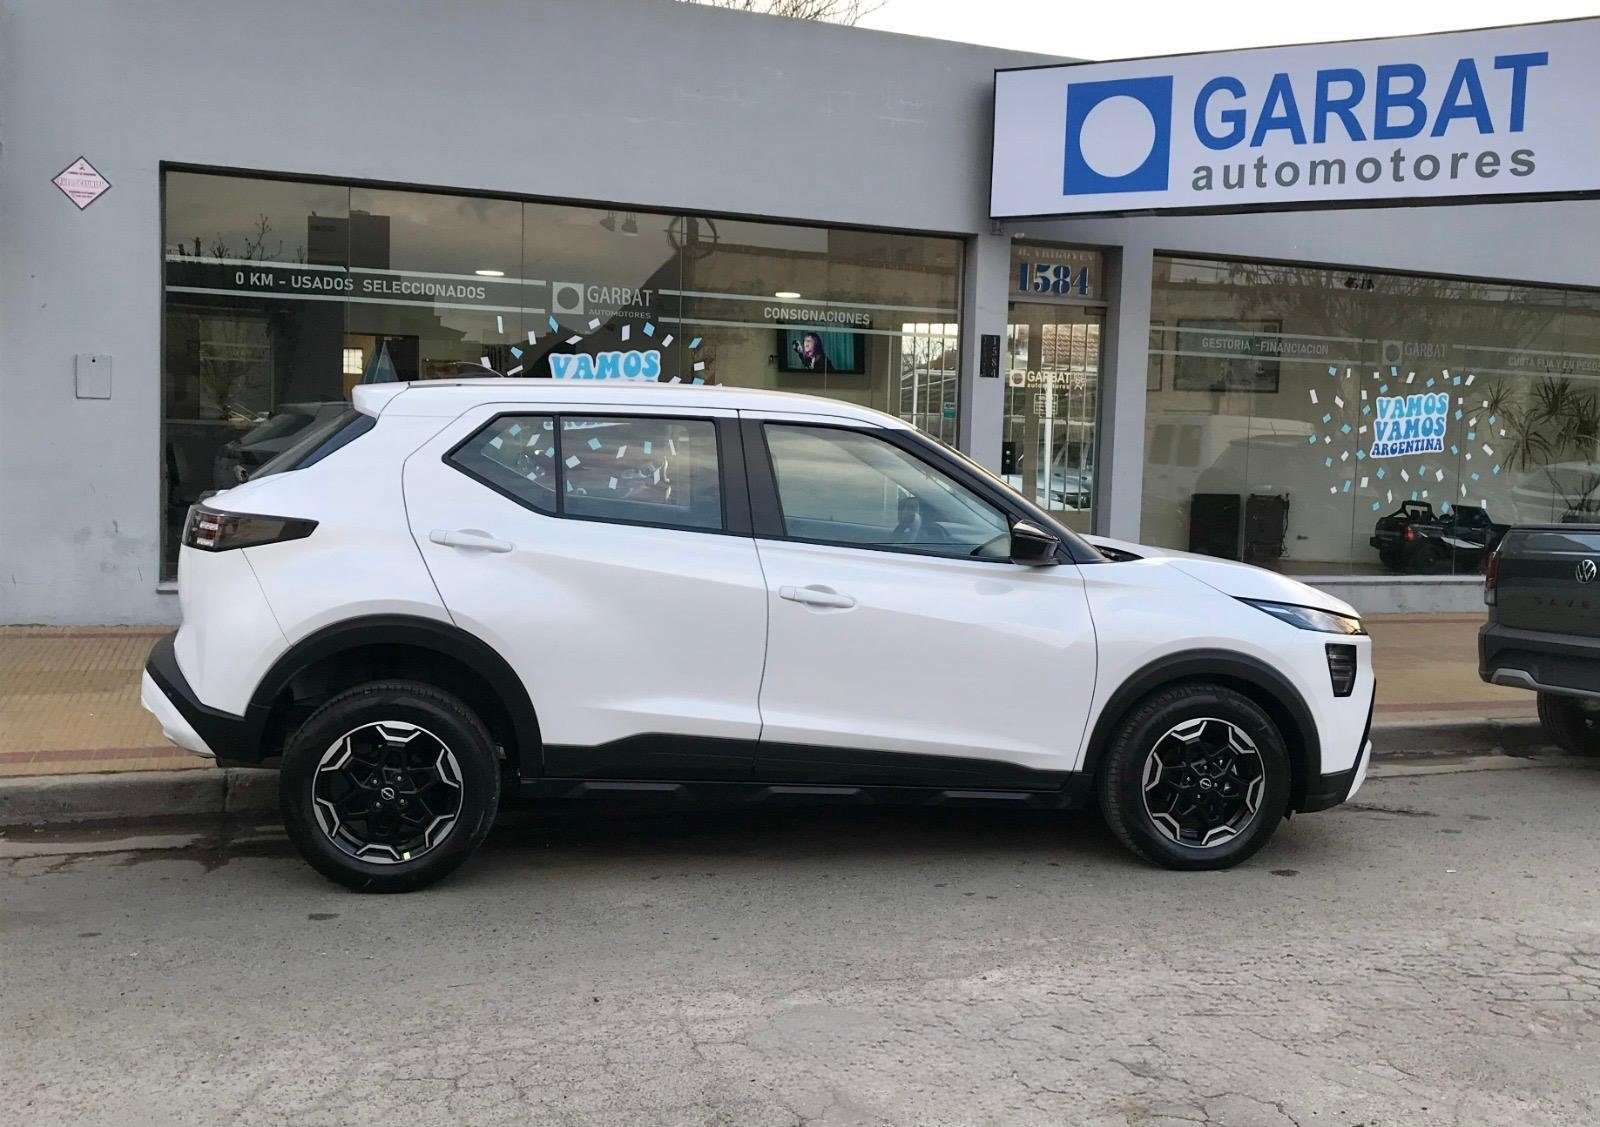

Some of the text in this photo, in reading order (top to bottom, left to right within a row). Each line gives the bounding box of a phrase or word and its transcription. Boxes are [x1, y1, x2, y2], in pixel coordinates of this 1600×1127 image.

[1193, 51, 1549, 151] GARBAT
[1191, 148, 1536, 191] automotores
[235, 271, 245, 285] 0
[250, 272, 274, 287] KM
[291, 275, 354, 291] USADOS
[362, 279, 486, 299] SELECCIONADOS
[1018, 263, 1090, 296] 1584
[587, 285, 653, 307] GARBAT
[588, 308, 652, 319] AUTOMOTORES
[763, 306, 870, 325] CONSIGNACIONES
[1201, 337, 1251, 351] GESTORIA
[1404, 342, 1447, 358] GARBAT
[550, 351, 659, 380] VAMOS
[1027, 371, 1071, 384] GARBAT
[1377, 394, 1448, 419] VAMOS
[1374, 417, 1445, 441] VAMOS
[1371, 438, 1443, 456] ARGENTINA
